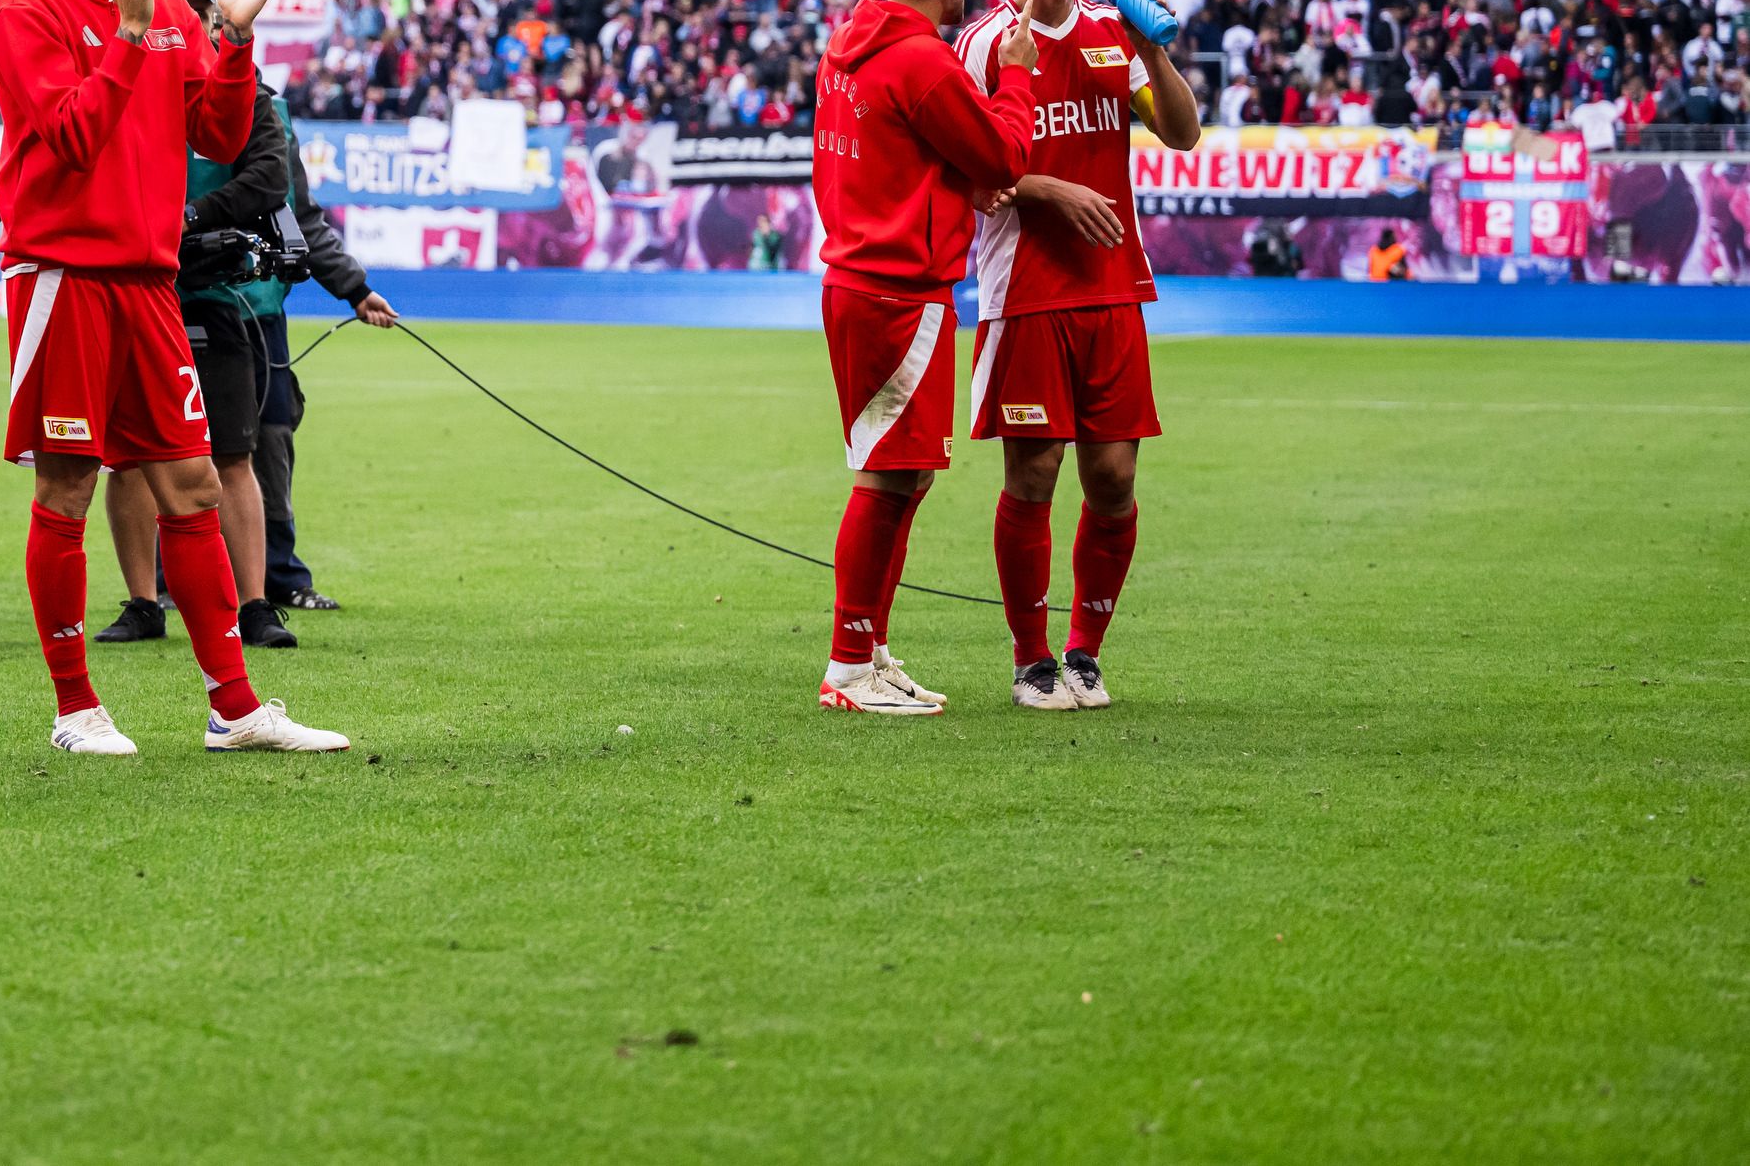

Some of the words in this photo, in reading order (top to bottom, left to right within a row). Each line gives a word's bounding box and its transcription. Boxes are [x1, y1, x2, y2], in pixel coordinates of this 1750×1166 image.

[1032, 94, 1120, 140] BERLIN
[178, 365, 207, 422] 2
[68, 426, 86, 435] UNION
